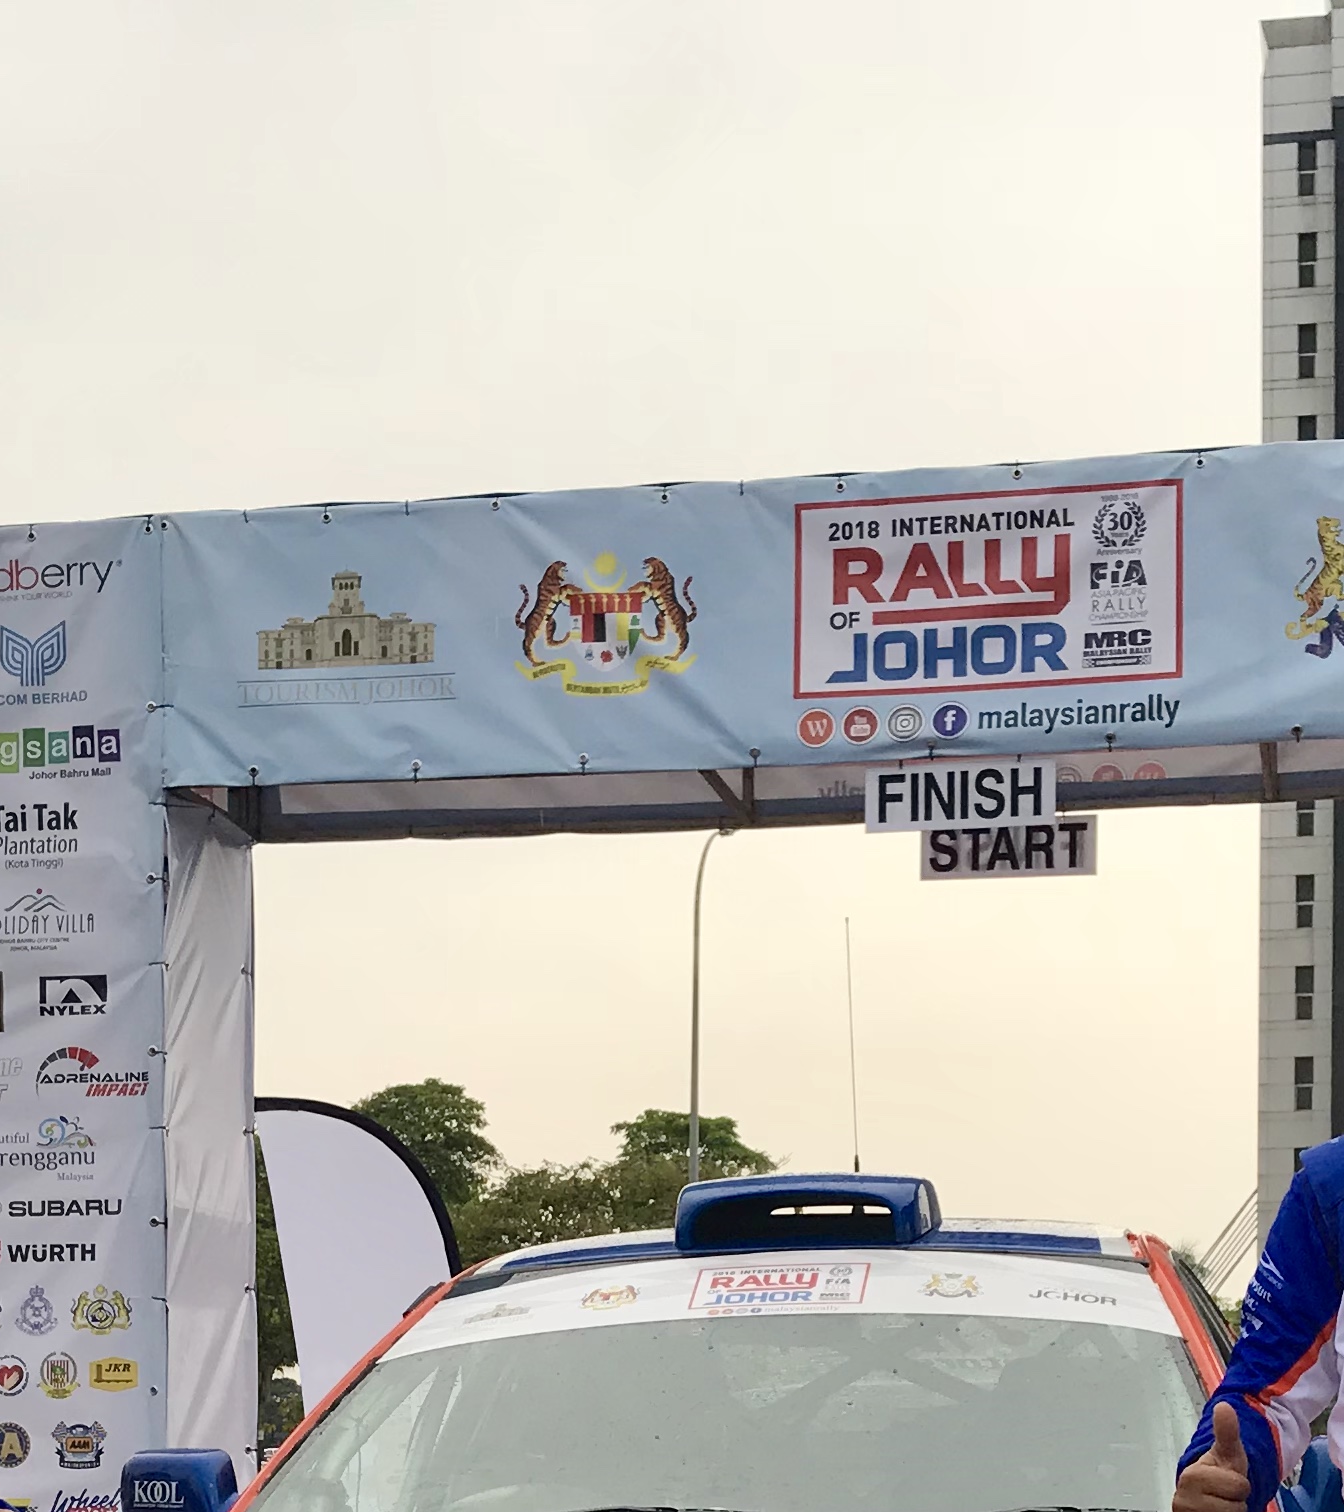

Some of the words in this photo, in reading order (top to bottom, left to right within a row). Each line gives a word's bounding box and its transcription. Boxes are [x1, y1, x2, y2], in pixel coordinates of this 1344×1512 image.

[828, 519, 880, 541] 2018
[891, 508, 1075, 538] INTERNATIONAL
[1107, 511, 1133, 531] 30
[832, 533, 1071, 612] RALLY
[1092, 597, 1146, 612] RALLY
[830, 612, 860, 630] OF
[1084, 629, 1152, 649] MRC
[825, 622, 1069, 684] JOHOR
[32, 690, 88, 705] BERHAD
[239, 682, 359, 705] TOURISM
[363, 677, 455, 705] JOHOR
[978, 694, 1180, 734] malaysianrally
[29, 770, 57, 780] Johor
[60, 769, 89, 778] Bahru
[92, 768, 111, 777] Mall
[878, 767, 1042, 823] FINISH
[33, 802, 78, 830] Tak
[929, 822, 1088, 872] START
[5, 859, 29, 869] (Kota
[31, 858, 64, 870] Tinggi)
[56, 913, 94, 933] VILLA
[40, 1004, 107, 1016] NYLEX
[40, 1071, 150, 1085] ADRENALINE
[85, 1082, 148, 1097] IMPACT
[57, 1172, 94, 1181] Malaysia
[8, 1199, 123, 1217] SUBARU
[710, 1273, 819, 1290] RALLY
[703, 1290, 813, 1306] JOHOR
[105, 1363, 131, 1373] JKR
[134, 1481, 184, 1503] KOOL
